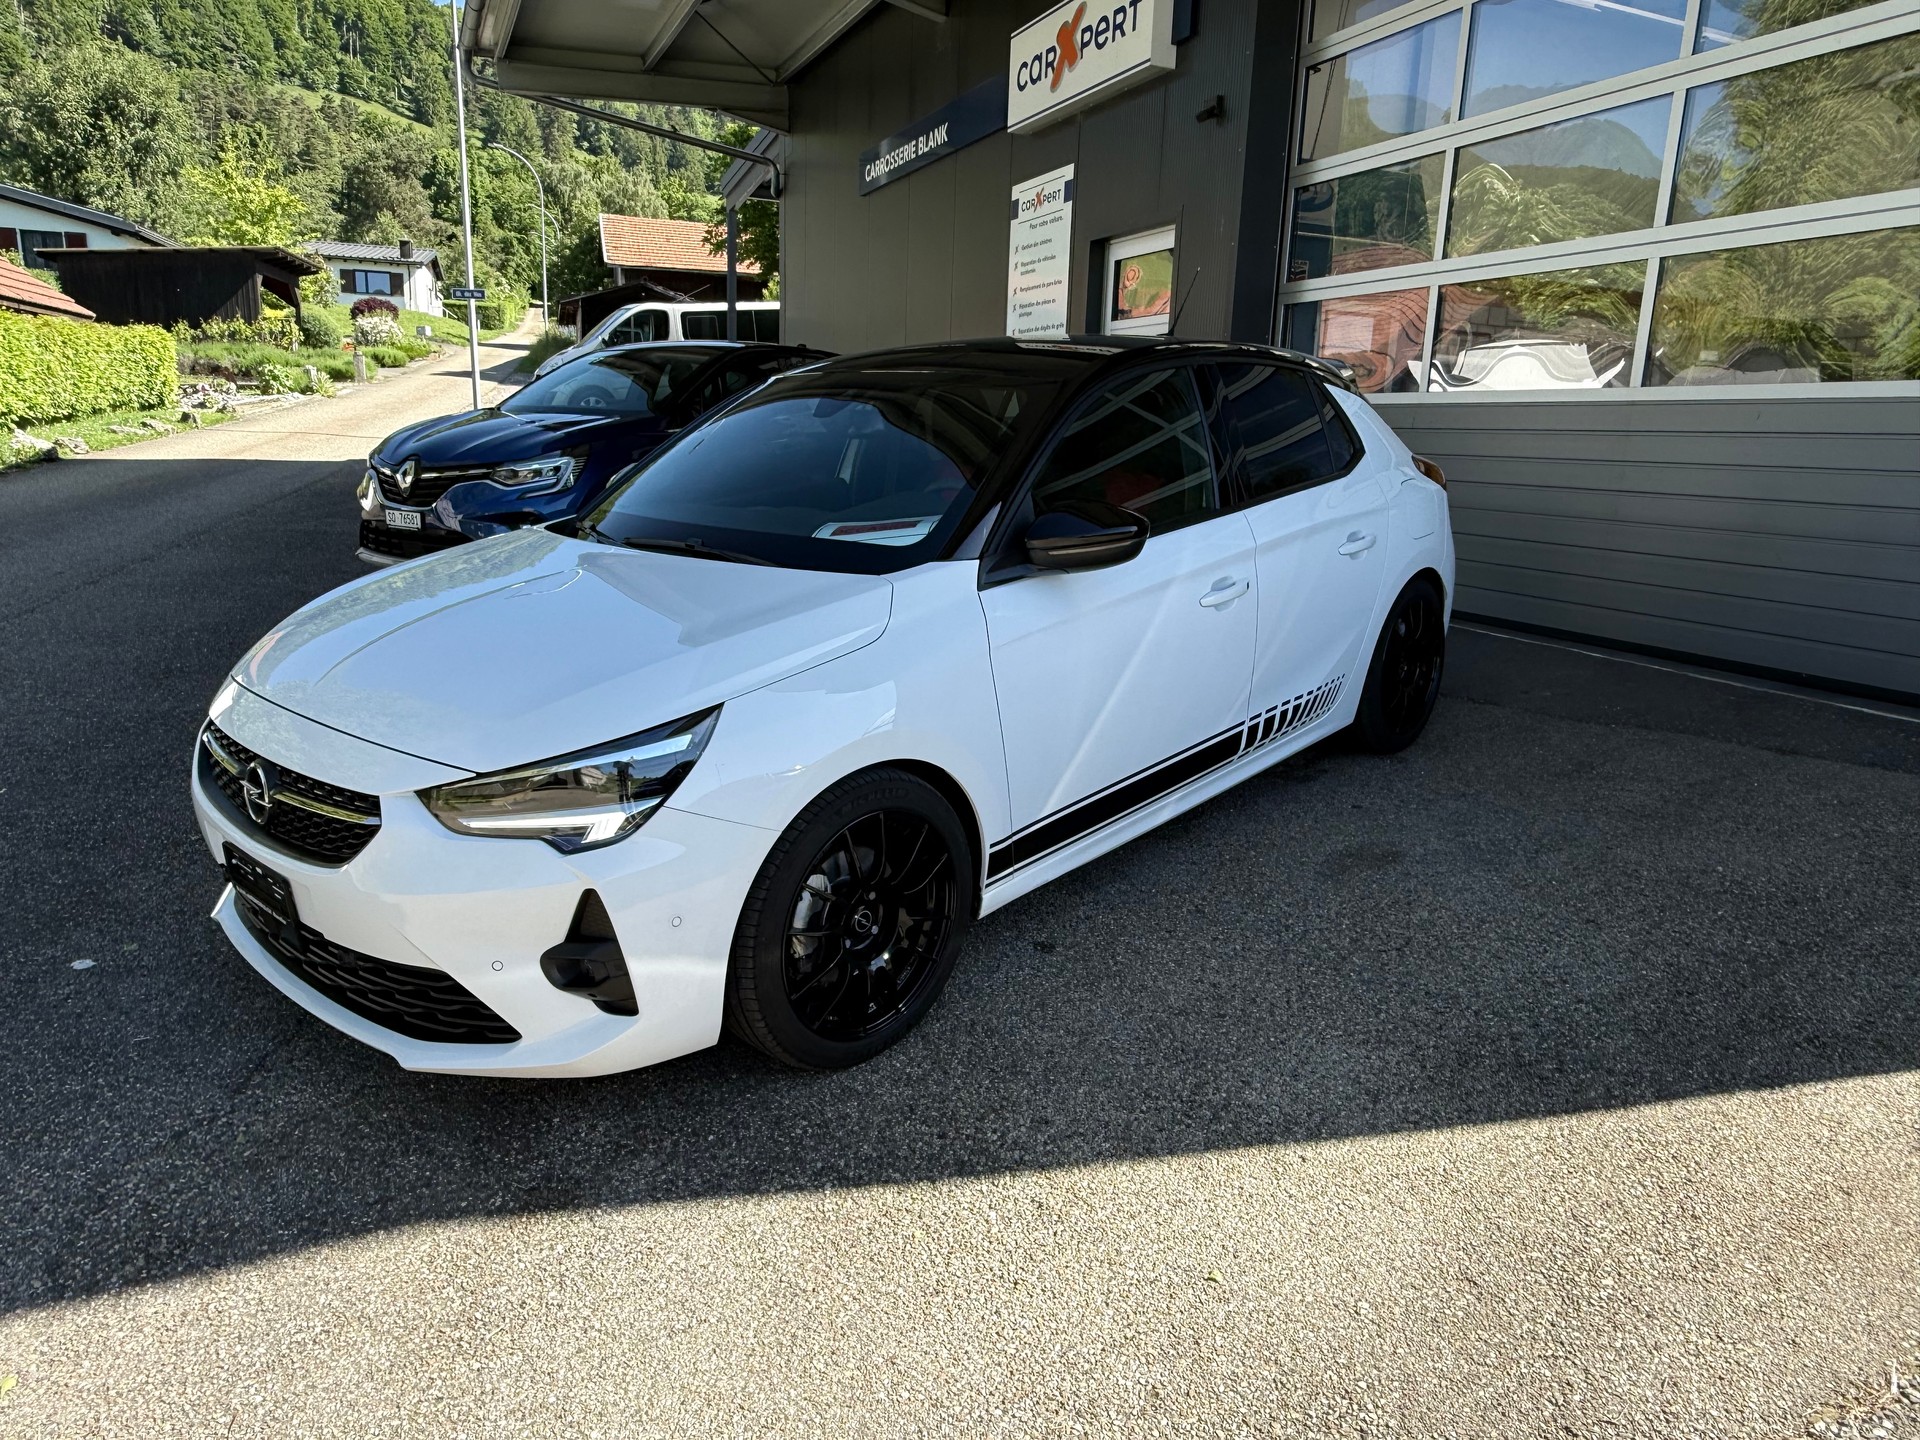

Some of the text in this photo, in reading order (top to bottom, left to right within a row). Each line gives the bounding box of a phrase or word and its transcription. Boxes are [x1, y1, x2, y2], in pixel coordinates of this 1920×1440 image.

[865, 122, 949, 182] CARROSSERIE BLANK
[388, 511, 419, 526] SO 76581
